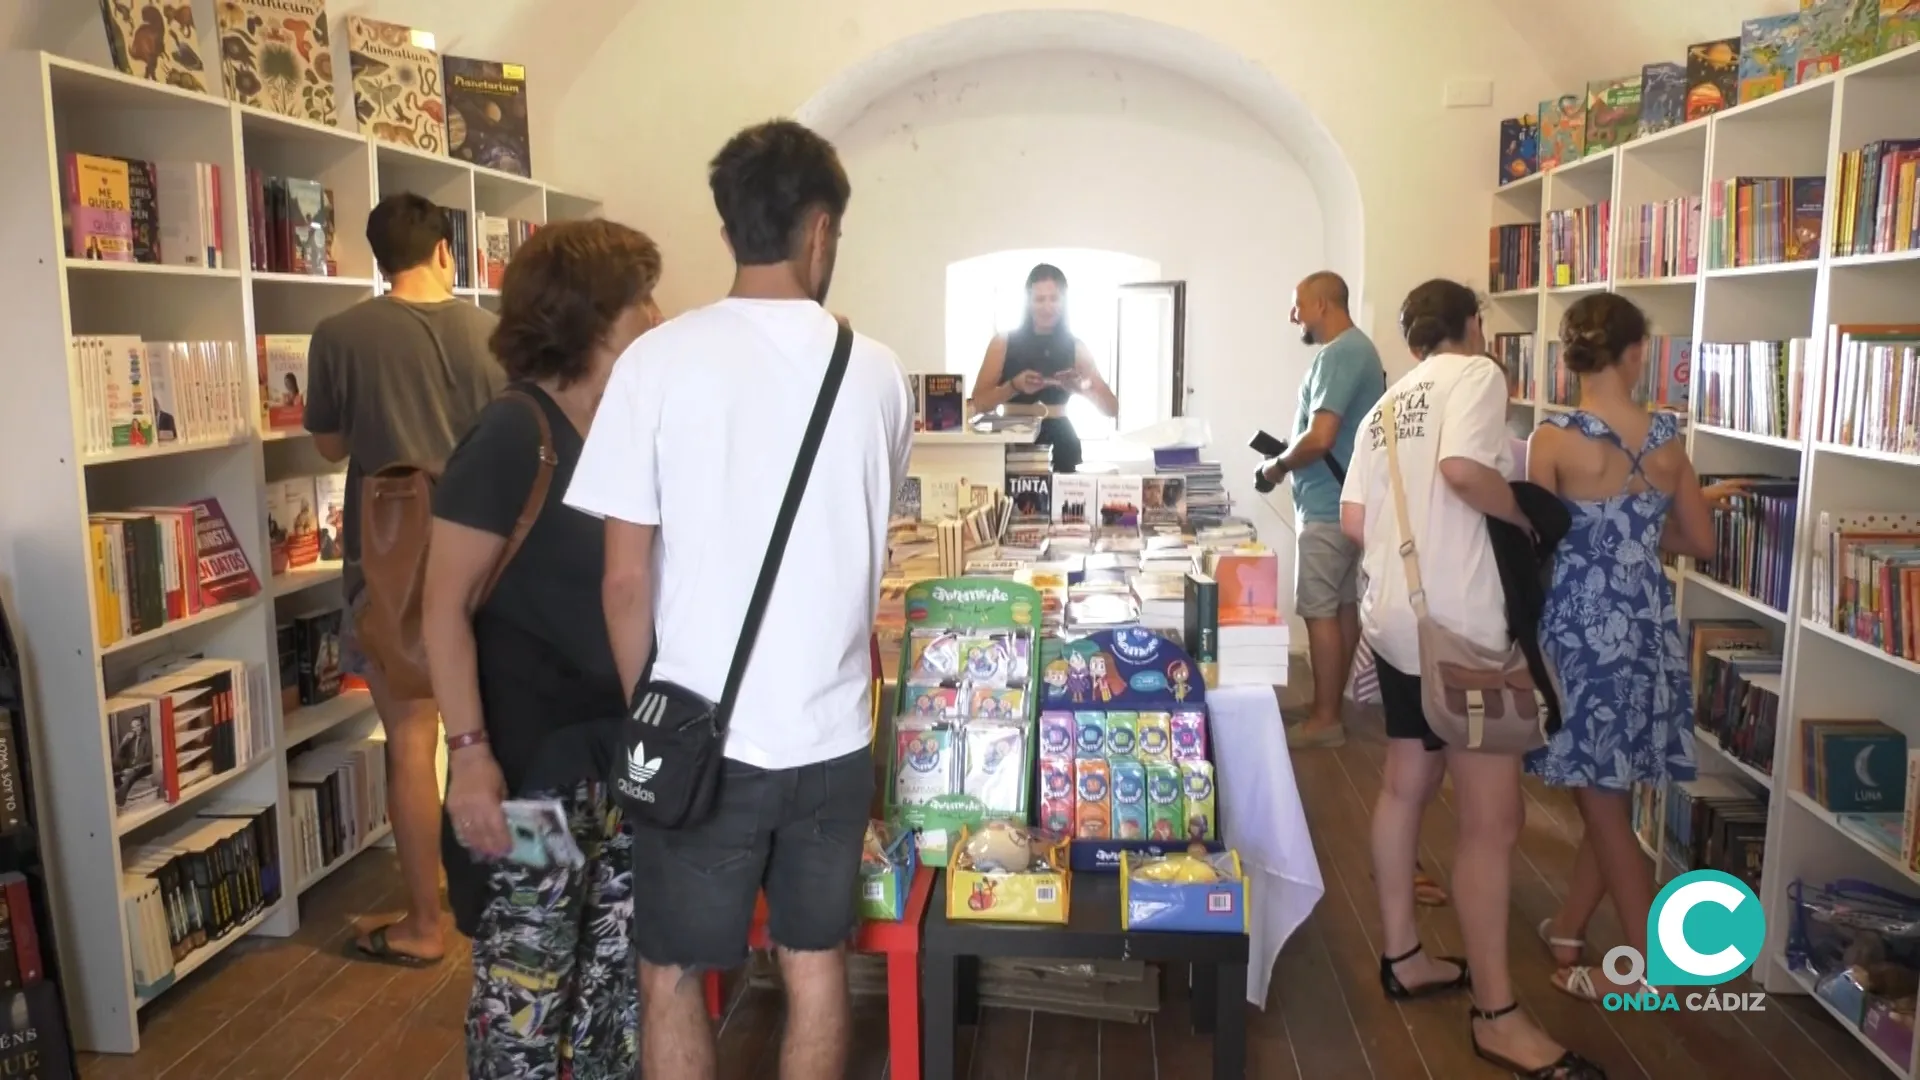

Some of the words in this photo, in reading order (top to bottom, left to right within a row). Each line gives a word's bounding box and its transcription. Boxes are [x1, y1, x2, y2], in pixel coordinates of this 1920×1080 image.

[361, 40, 431, 64] Animalium
[453, 74, 519, 93] Planetarium
[98, 188, 113, 199] ME
[88, 198, 124, 211] QUIERO
[1009, 478, 1049, 494] TINTA
[212, 552, 246, 576] DATOS
[617, 777, 656, 804] adidas
[1854, 790, 1883, 802] LUNA
